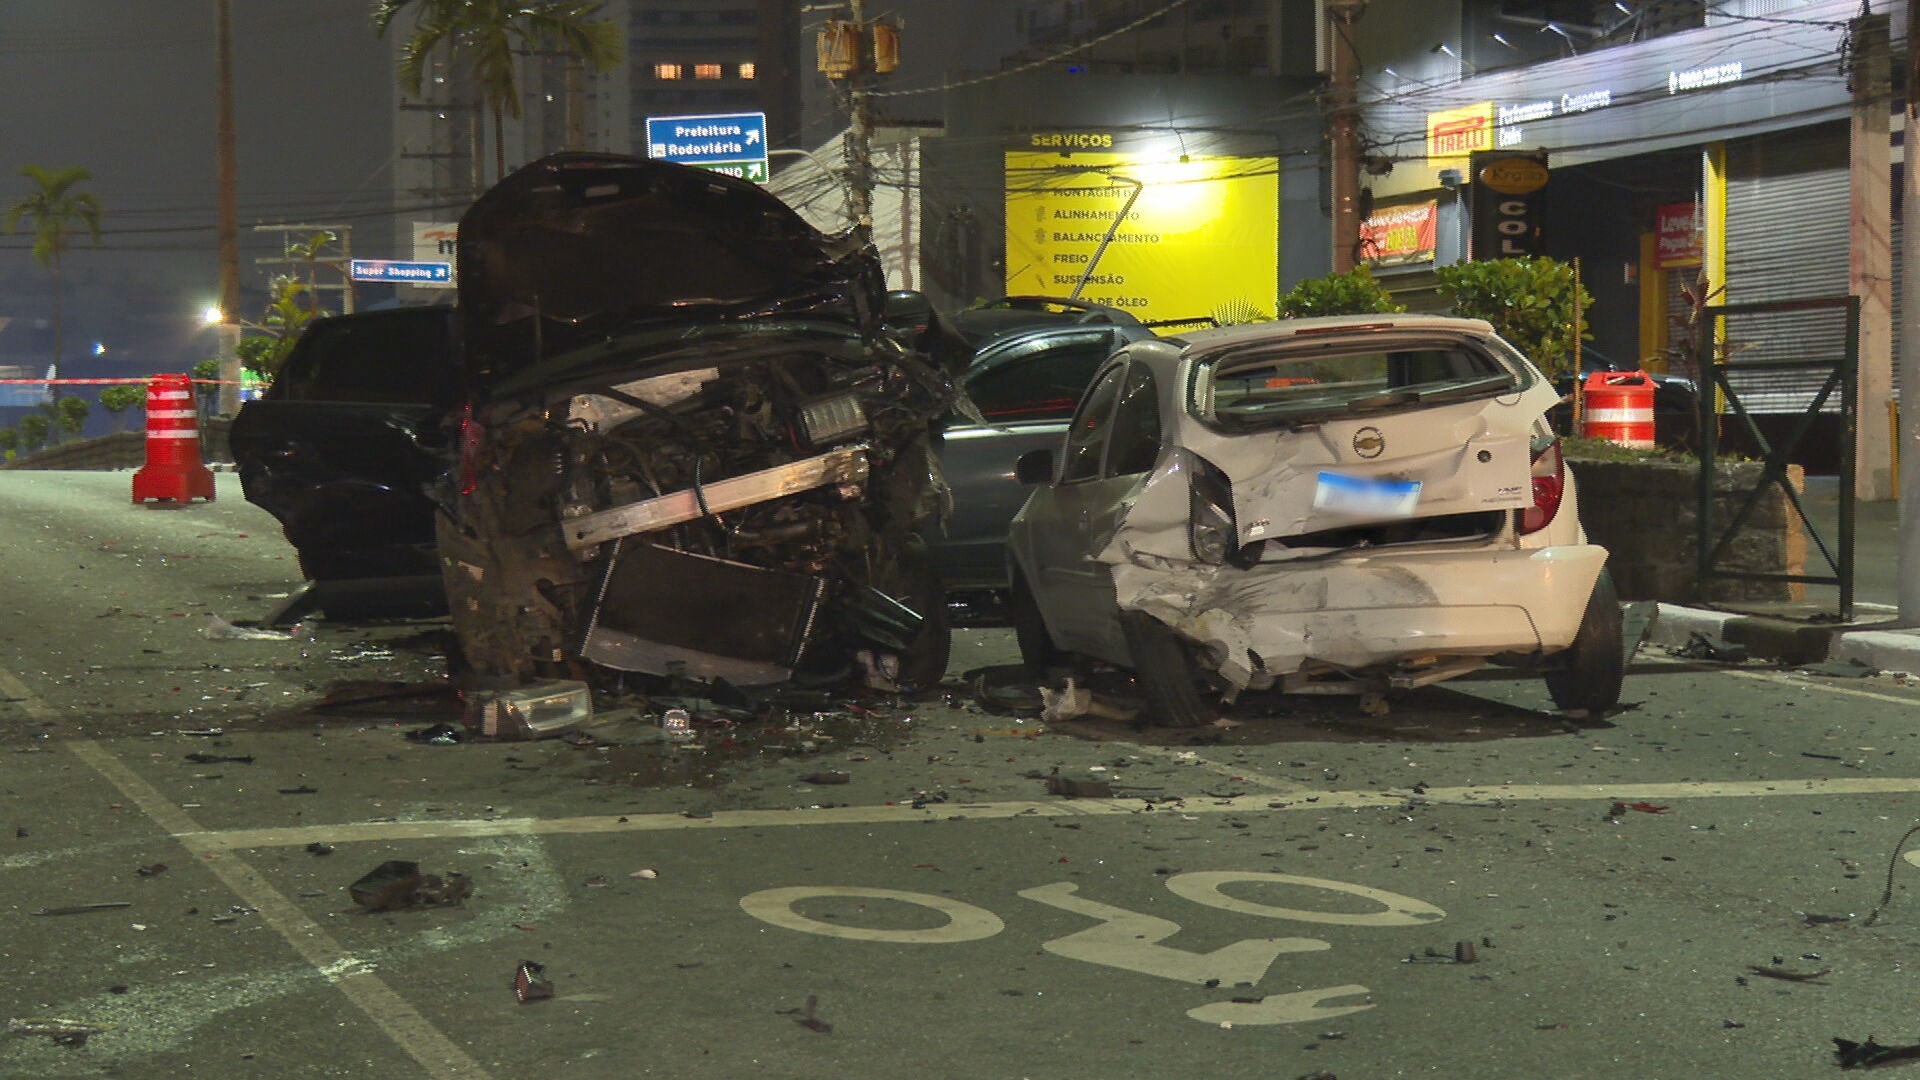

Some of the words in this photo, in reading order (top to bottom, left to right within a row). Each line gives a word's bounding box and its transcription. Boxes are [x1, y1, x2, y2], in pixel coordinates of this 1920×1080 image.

[676, 125, 741, 137] Prefeitura
[1434, 115, 1486, 155] PIRELLI
[1031, 133, 1113, 149] SERVIÇOS
[669, 142, 742, 155] Rodoviária
[1053, 254, 1089, 264] FREIO
[356, 266, 384, 275] Super
[388, 267, 432, 279] Shopping
[1053, 273, 1124, 284] SUSPNSÃO
[1115, 295, 1148, 307] ÓLEO
